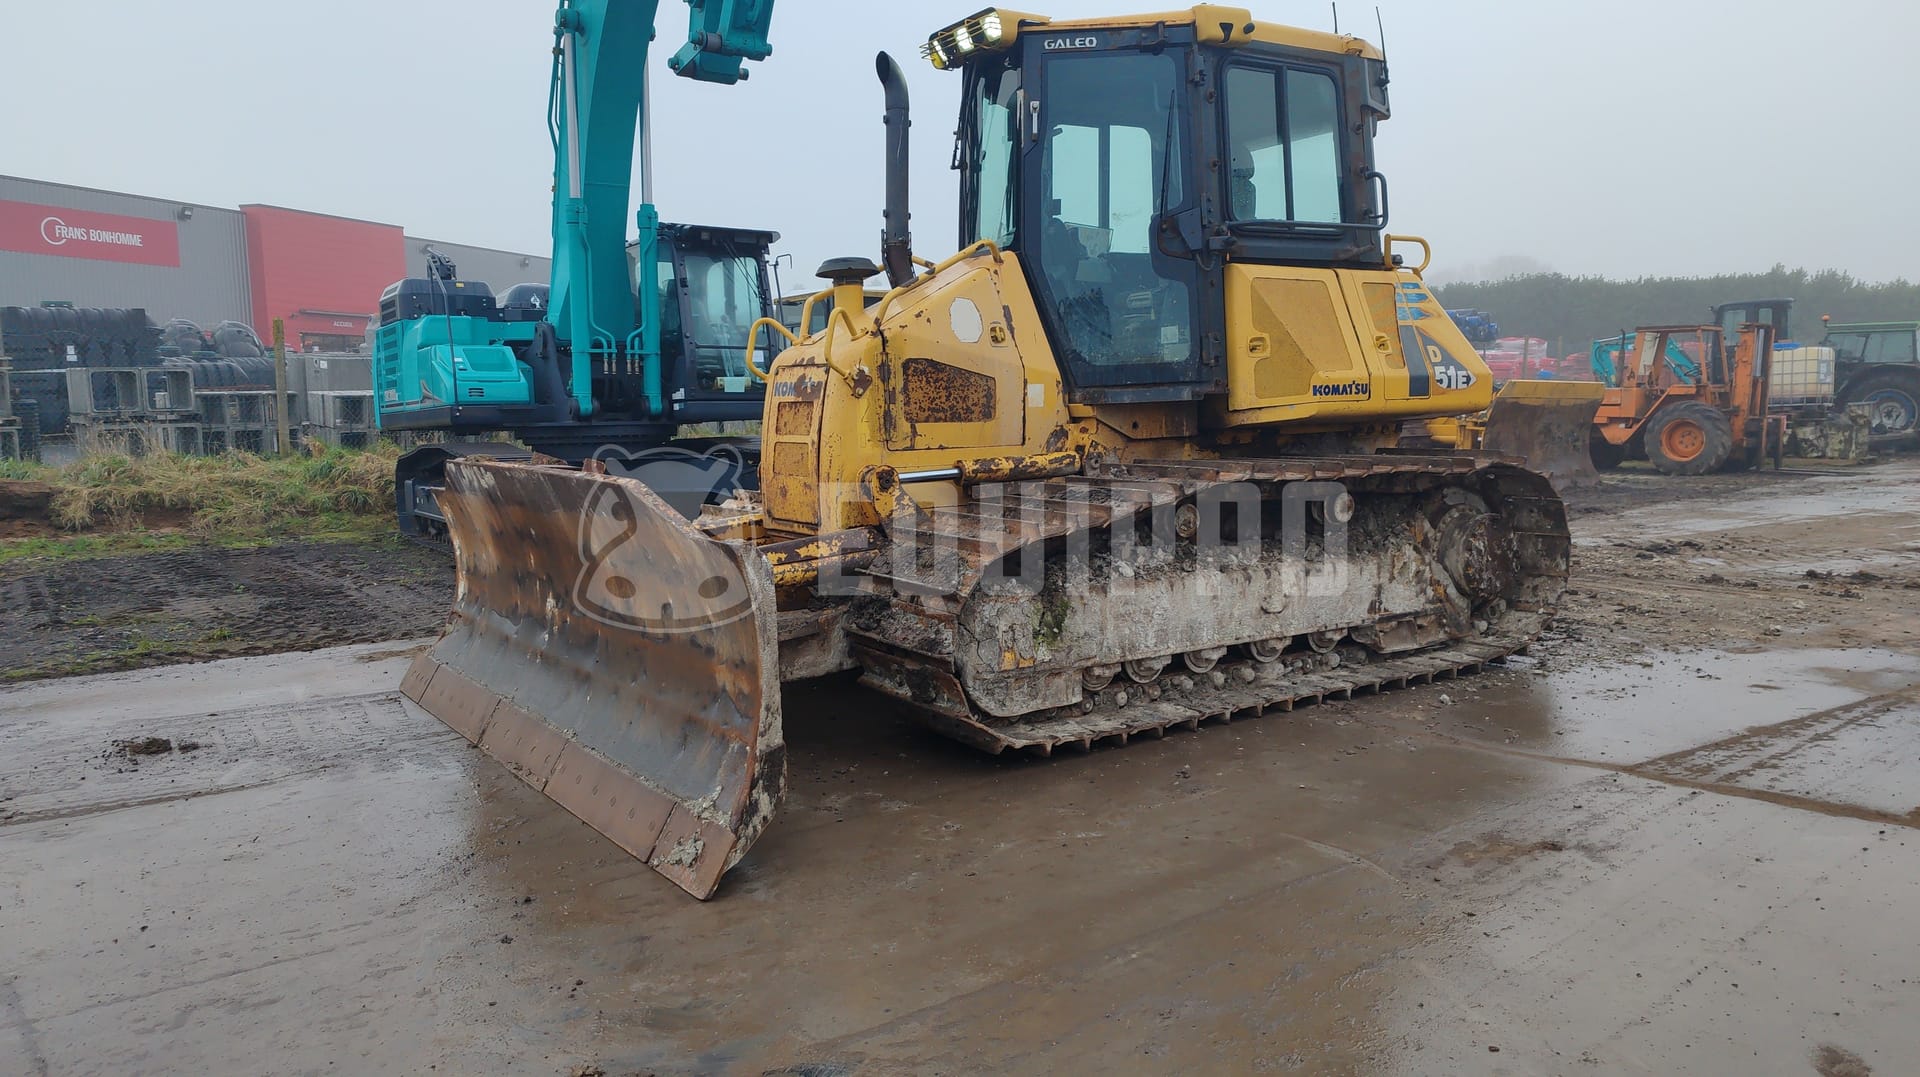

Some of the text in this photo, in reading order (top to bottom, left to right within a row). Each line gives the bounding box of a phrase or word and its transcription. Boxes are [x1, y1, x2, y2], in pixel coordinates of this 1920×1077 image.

[1044, 37, 1097, 49] GALEO
[55, 225, 143, 247] FRANS BONHOMME
[1427, 346, 1442, 363] D
[1434, 366, 1469, 390] 51E
[1312, 380, 1368, 396] KOMATSU
